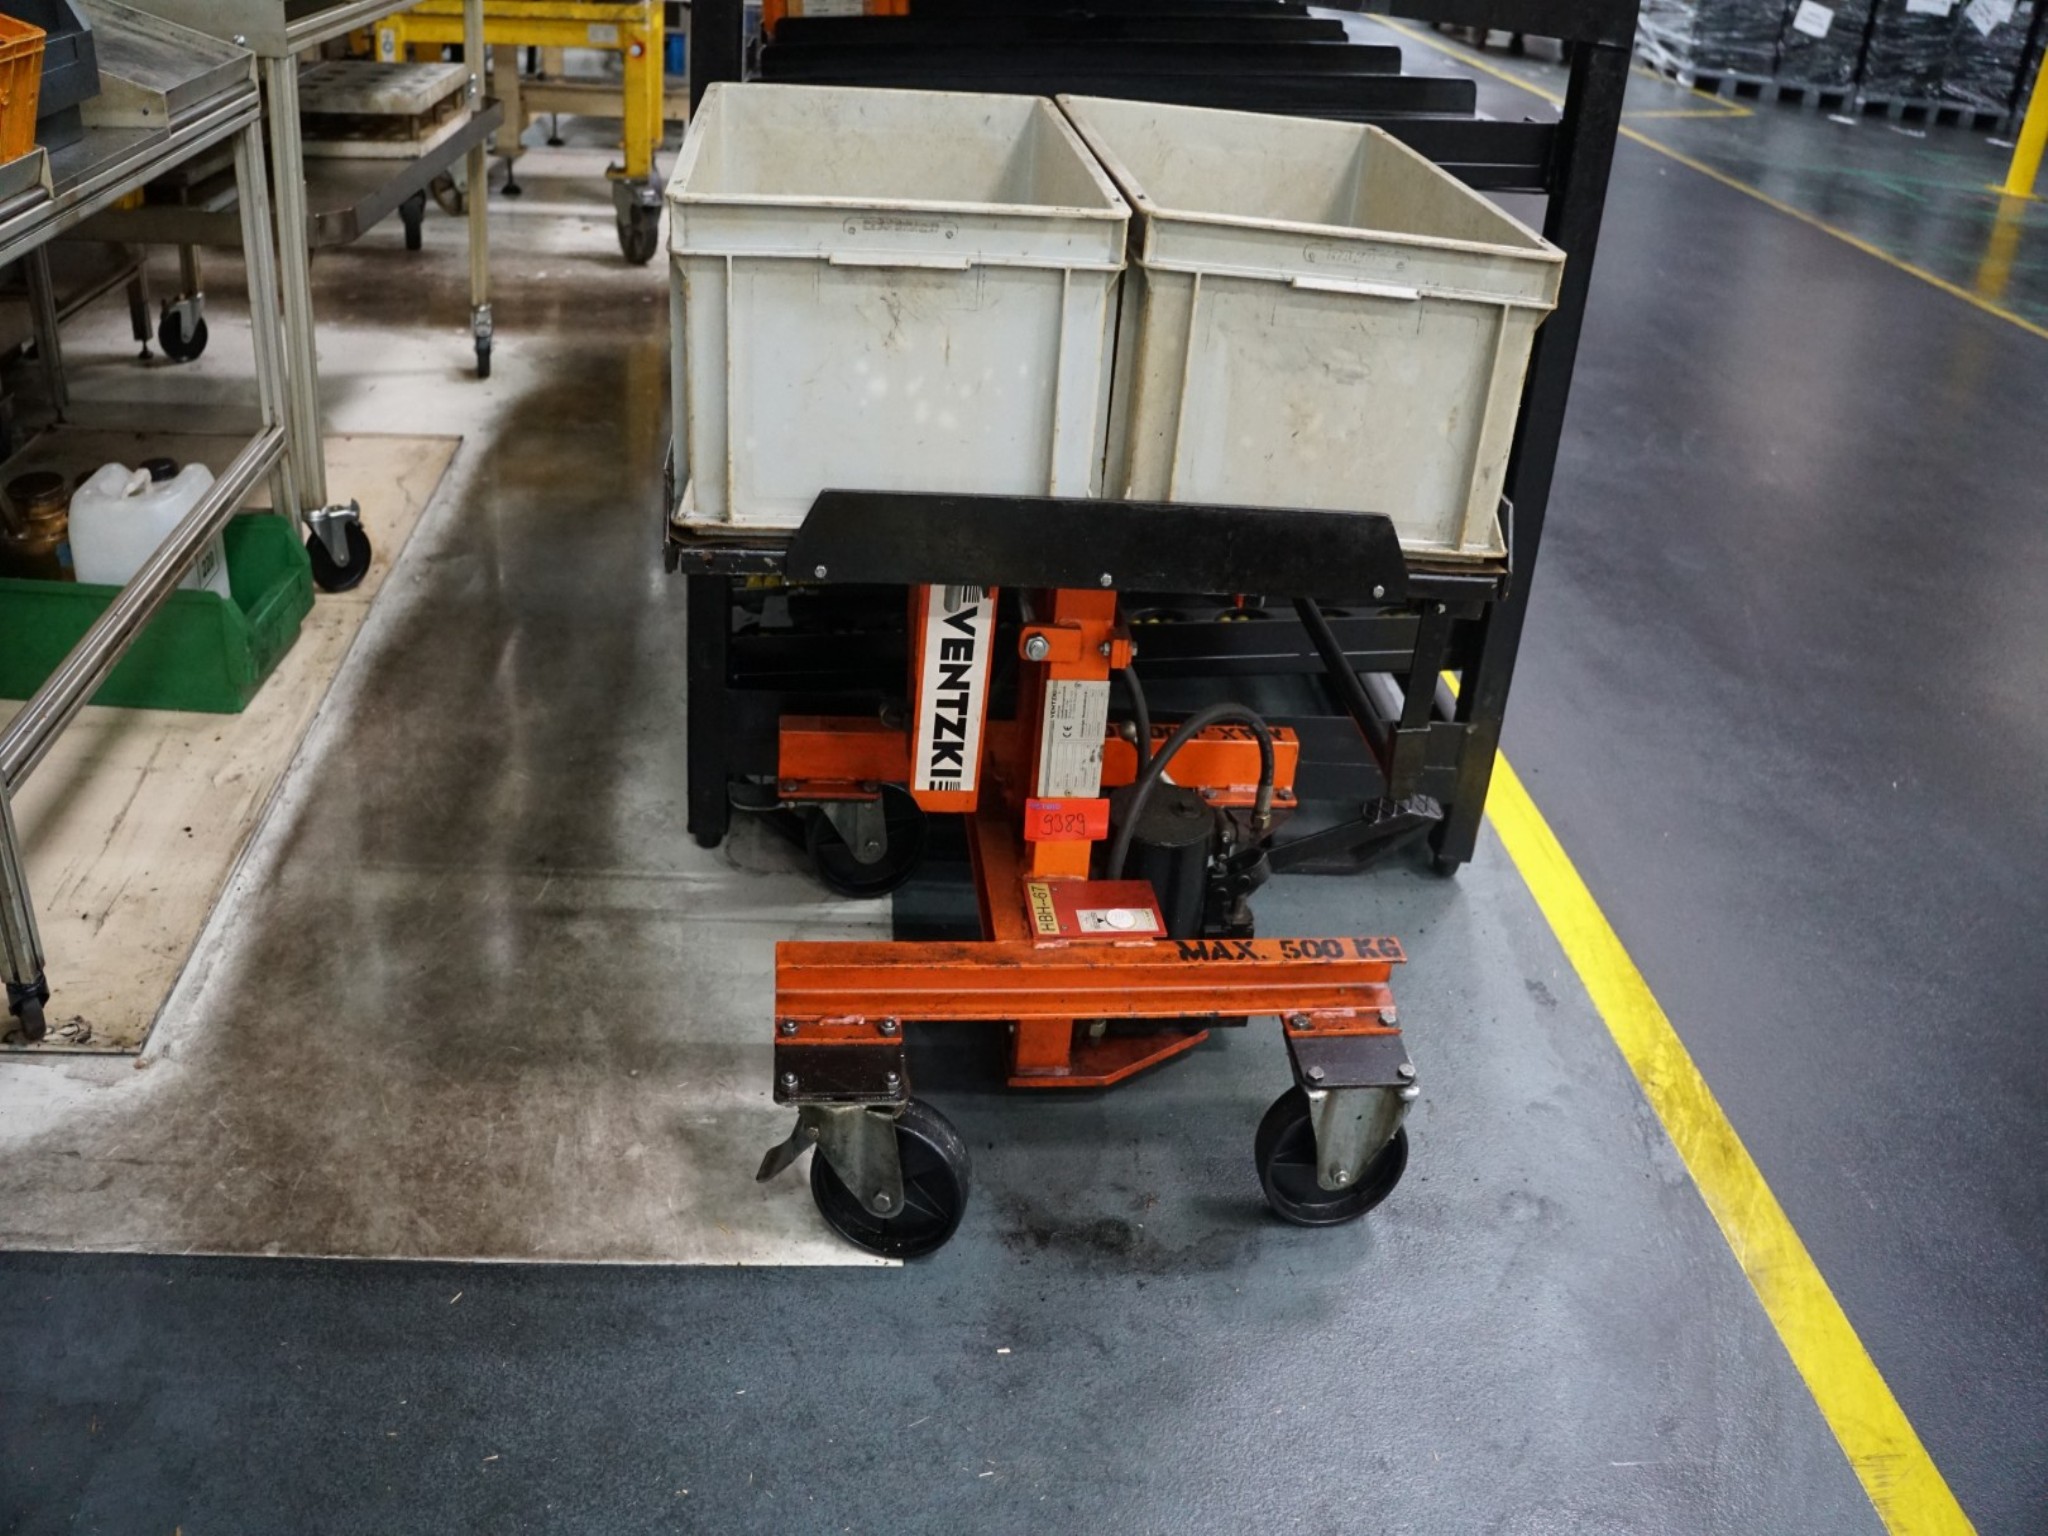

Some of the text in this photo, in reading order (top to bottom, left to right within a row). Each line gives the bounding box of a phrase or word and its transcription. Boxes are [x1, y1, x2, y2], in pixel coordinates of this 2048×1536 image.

[930, 606, 978, 778] VENTZKI
[1040, 812, 1086, 836] 9389
[1176, 937, 1401, 961] MAX. 500 KG
